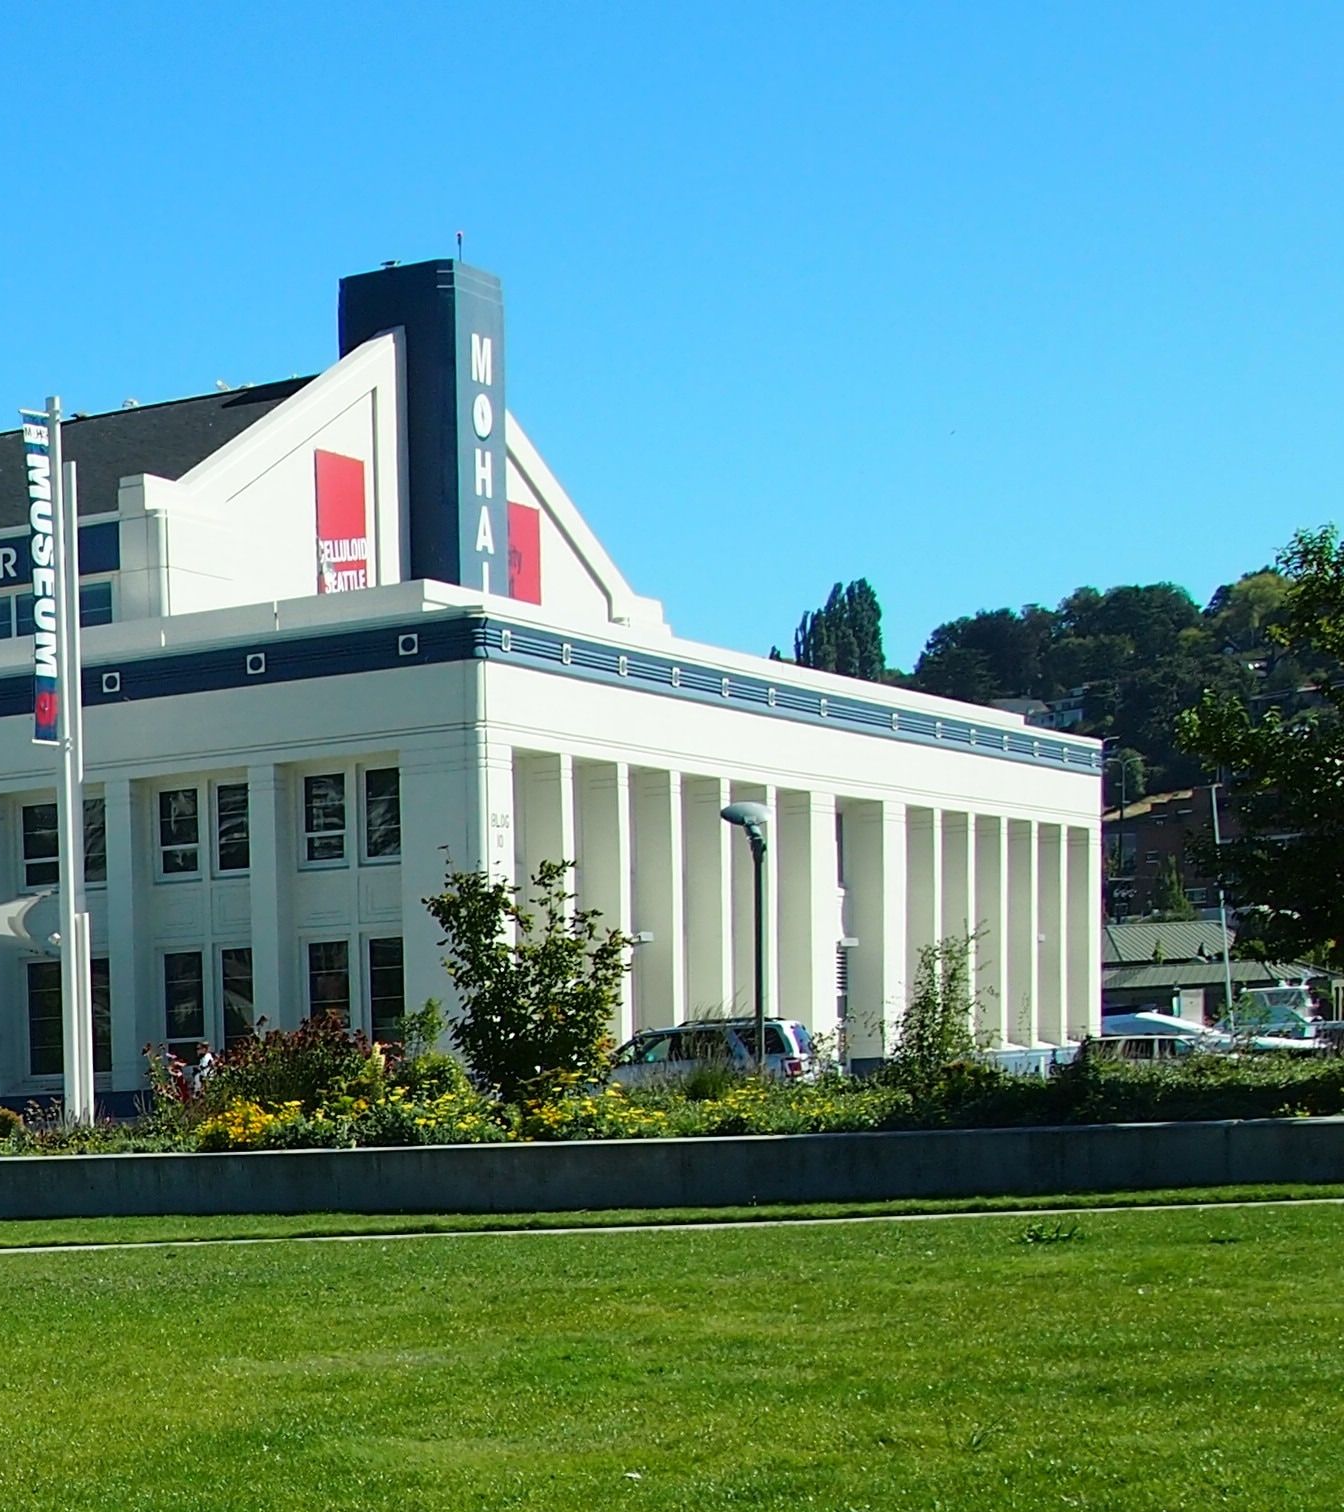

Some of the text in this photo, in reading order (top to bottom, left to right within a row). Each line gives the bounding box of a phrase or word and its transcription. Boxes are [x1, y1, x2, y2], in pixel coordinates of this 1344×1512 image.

[26, 453, 58, 679] MUSEUM
[471, 332, 495, 594] MOHAI
[324, 568, 366, 595] SEATTLE
